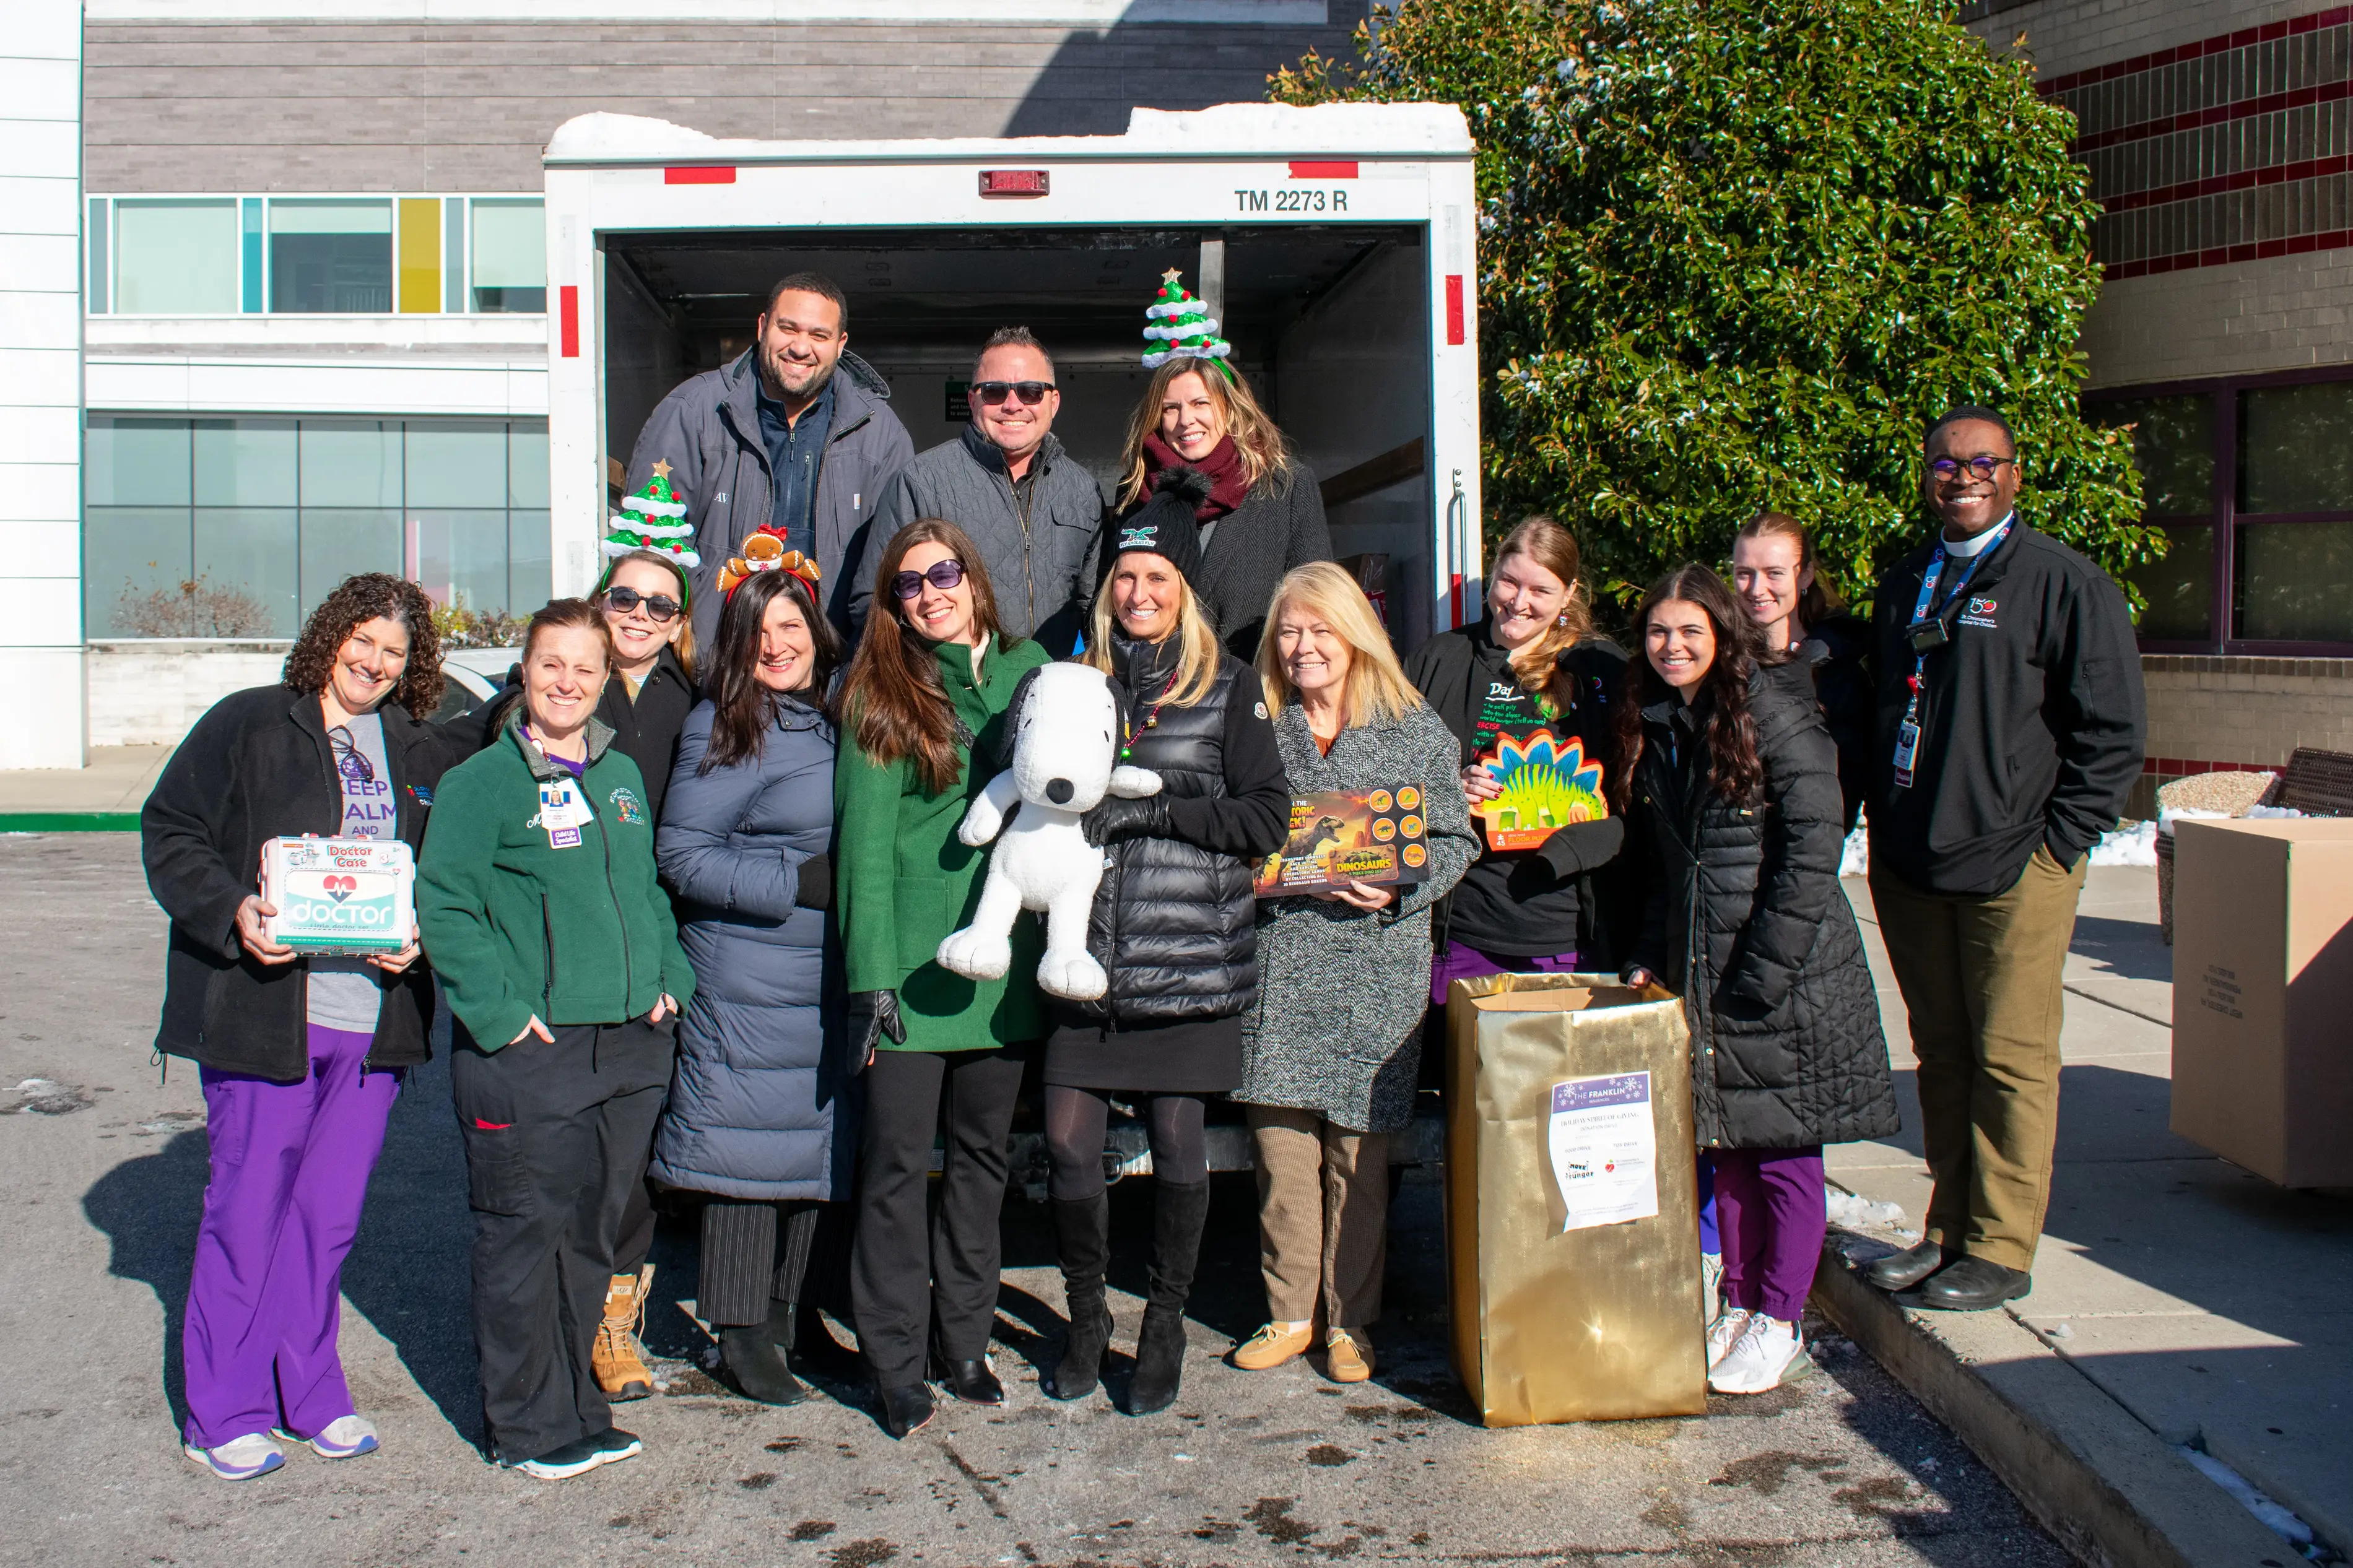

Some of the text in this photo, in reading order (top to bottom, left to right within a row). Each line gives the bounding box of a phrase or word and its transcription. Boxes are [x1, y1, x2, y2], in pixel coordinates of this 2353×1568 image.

[1234, 190, 1348, 211] TM 2273 R
[1969, 597, 1997, 613] 150
[1489, 682, 1515, 699] Day
[1477, 721, 1501, 730] ERCISE
[345, 803, 396, 820] ALM
[1291, 805, 1316, 817] TORIC
[1289, 816, 1307, 829] CK!
[351, 825, 379, 835] AND
[555, 836, 578, 845] Specialist
[327, 845, 373, 856] Doctor
[334, 857, 367, 867] Case
[1336, 858, 1393, 873] DINOSAURS
[290, 899, 393, 925] doctor
[1573, 1087, 1625, 1100] THE FRANKLIN
[1560, 1117, 1585, 1127] HOLIDAY
[1587, 1115, 1606, 1124] SPIRIT
